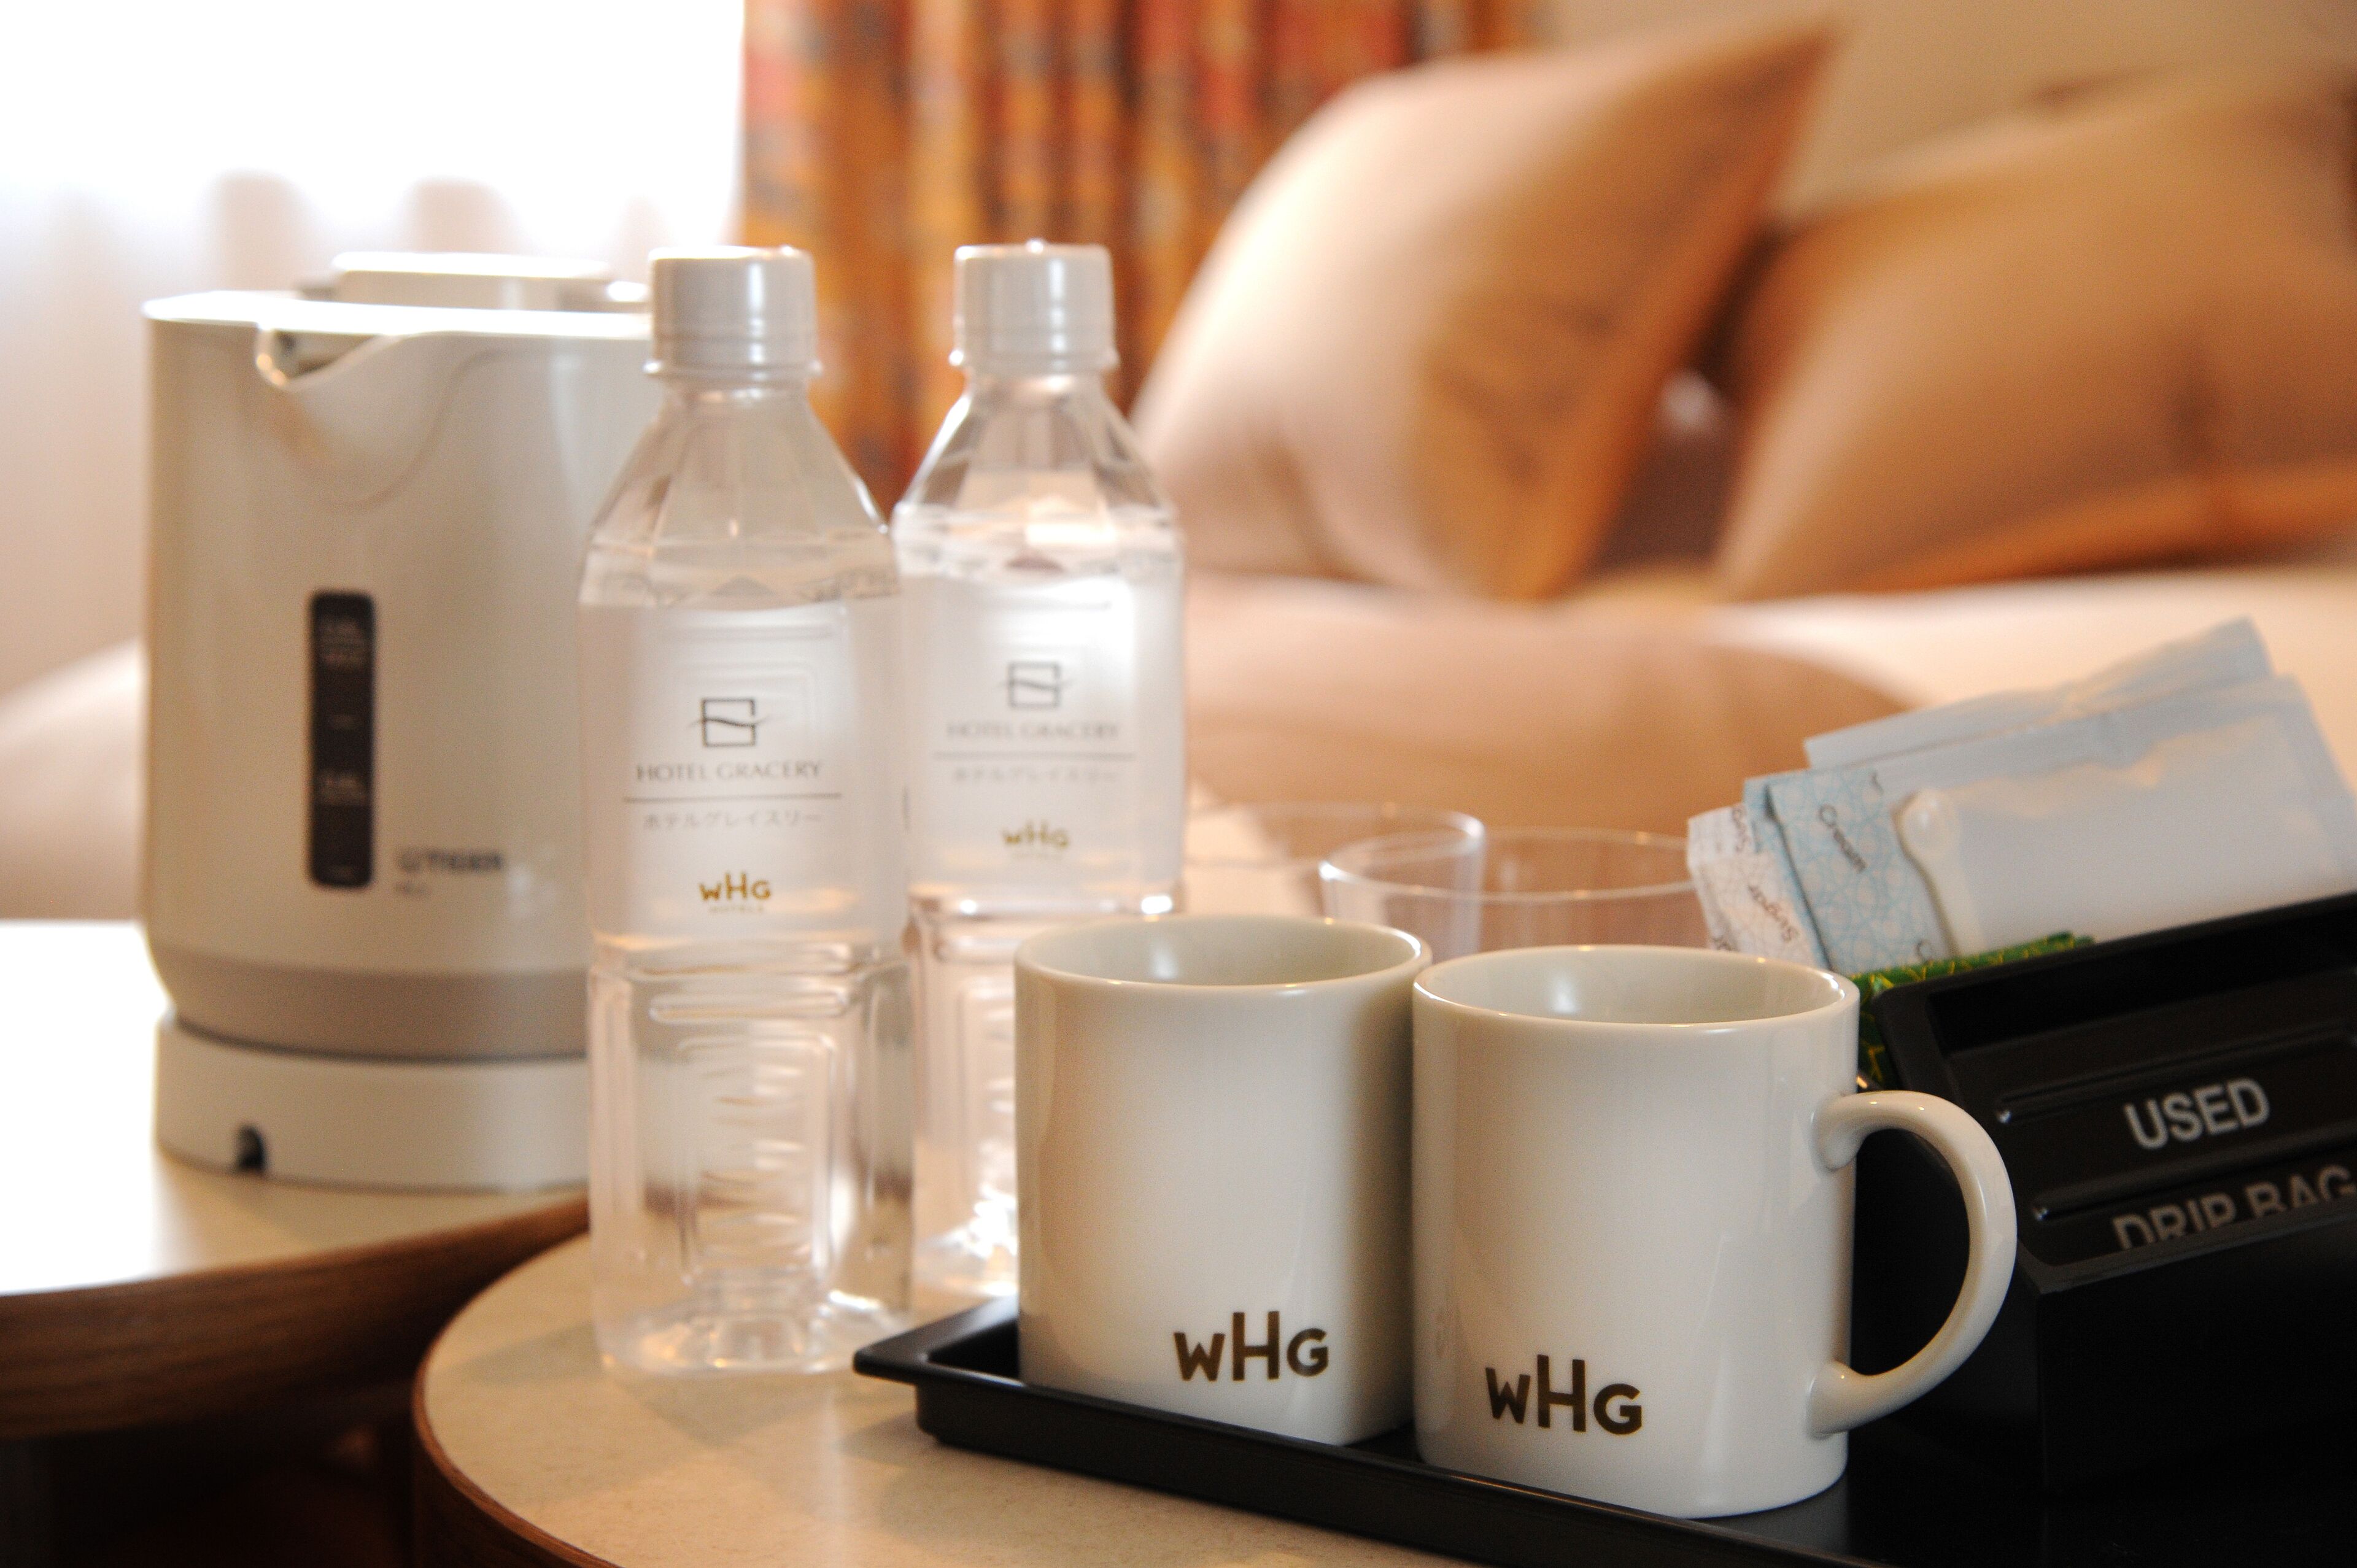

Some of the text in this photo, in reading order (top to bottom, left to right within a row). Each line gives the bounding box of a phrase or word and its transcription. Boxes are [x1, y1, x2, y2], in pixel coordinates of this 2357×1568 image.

[636, 759, 823, 782] HOTEL GRACERY
[2123, 1076, 2271, 1150] USED
[2111, 1163, 2357, 1250] DRIP BAG
